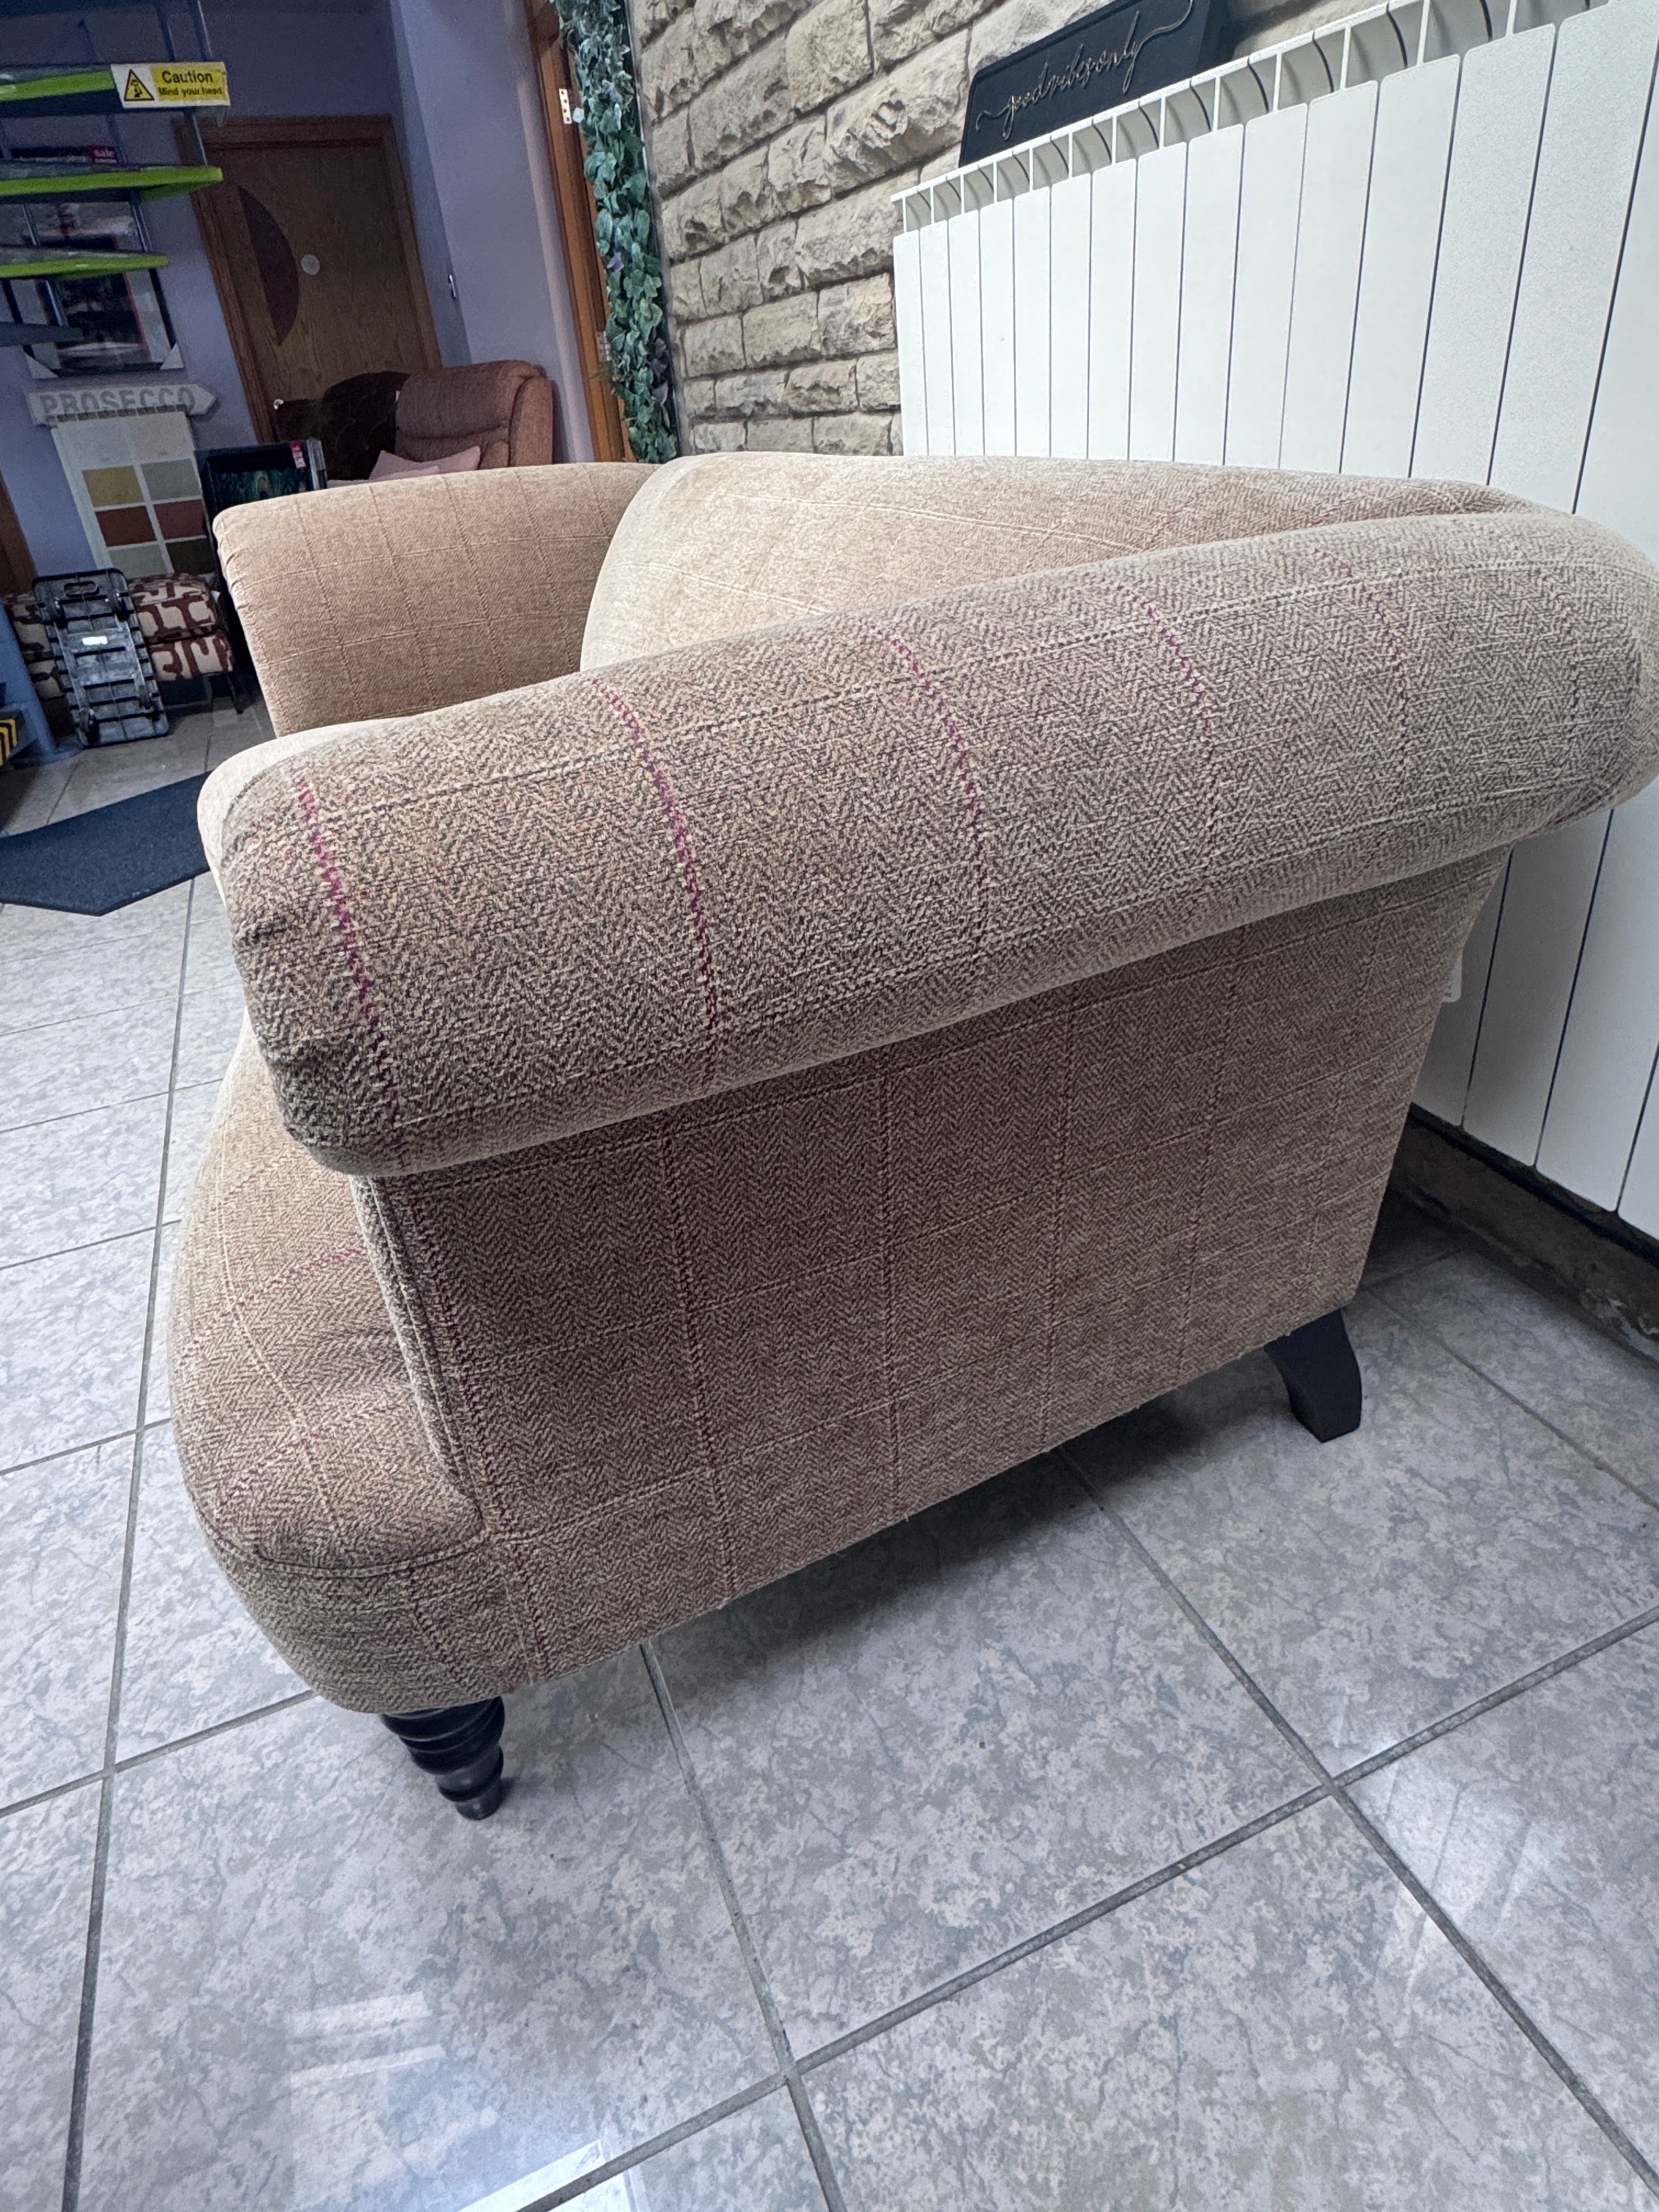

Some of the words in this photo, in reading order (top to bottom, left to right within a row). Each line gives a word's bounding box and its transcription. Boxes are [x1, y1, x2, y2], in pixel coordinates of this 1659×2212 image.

[161, 70, 213, 83] Caution
[182, 89, 200, 97] your
[39, 387, 195, 413] PROSECCO
